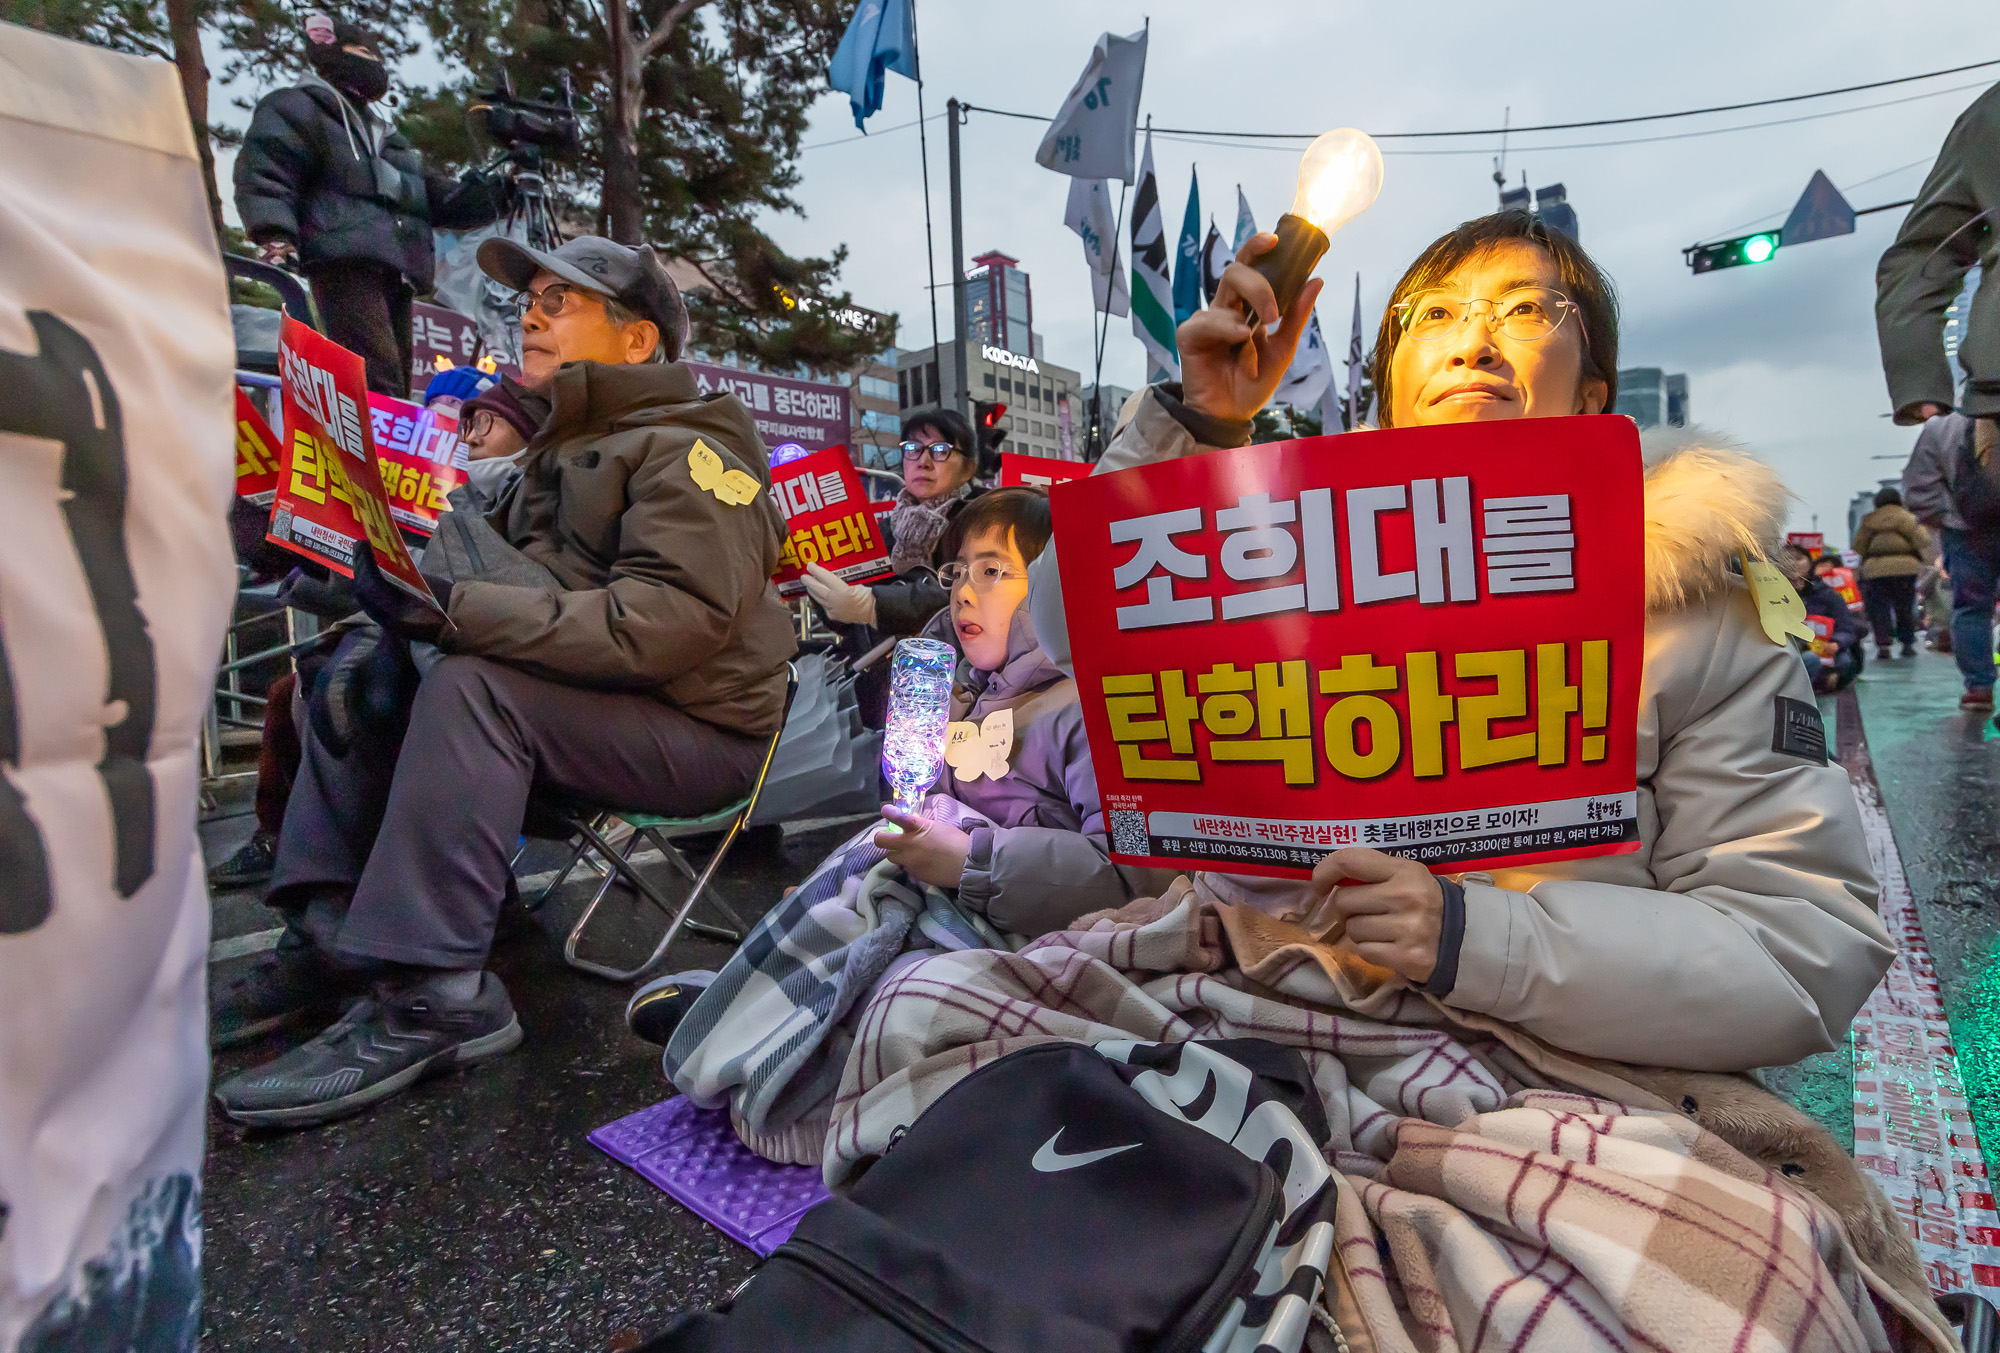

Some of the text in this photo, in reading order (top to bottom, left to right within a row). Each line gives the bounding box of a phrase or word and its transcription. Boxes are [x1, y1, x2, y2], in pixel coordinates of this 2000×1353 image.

[982, 344, 1039, 374] KODATA
[773, 385, 842, 421] 중단하라!
[1109, 476, 1575, 630] 조희대를
[1101, 639, 1609, 785] 탄핵하라!
[1162, 839, 1181, 852] 후원
[1189, 841, 1207, 854] 신한
[1210, 842, 1288, 861] 100-036-551308
[1568, 828, 1587, 841] 여러
[1589, 827, 1599, 839] 번
[1601, 823, 1624, 837] 가능)
[1193, 808, 1539, 846] 내란청산! 국민주권실현! 촛불대행진으로 모이자!
